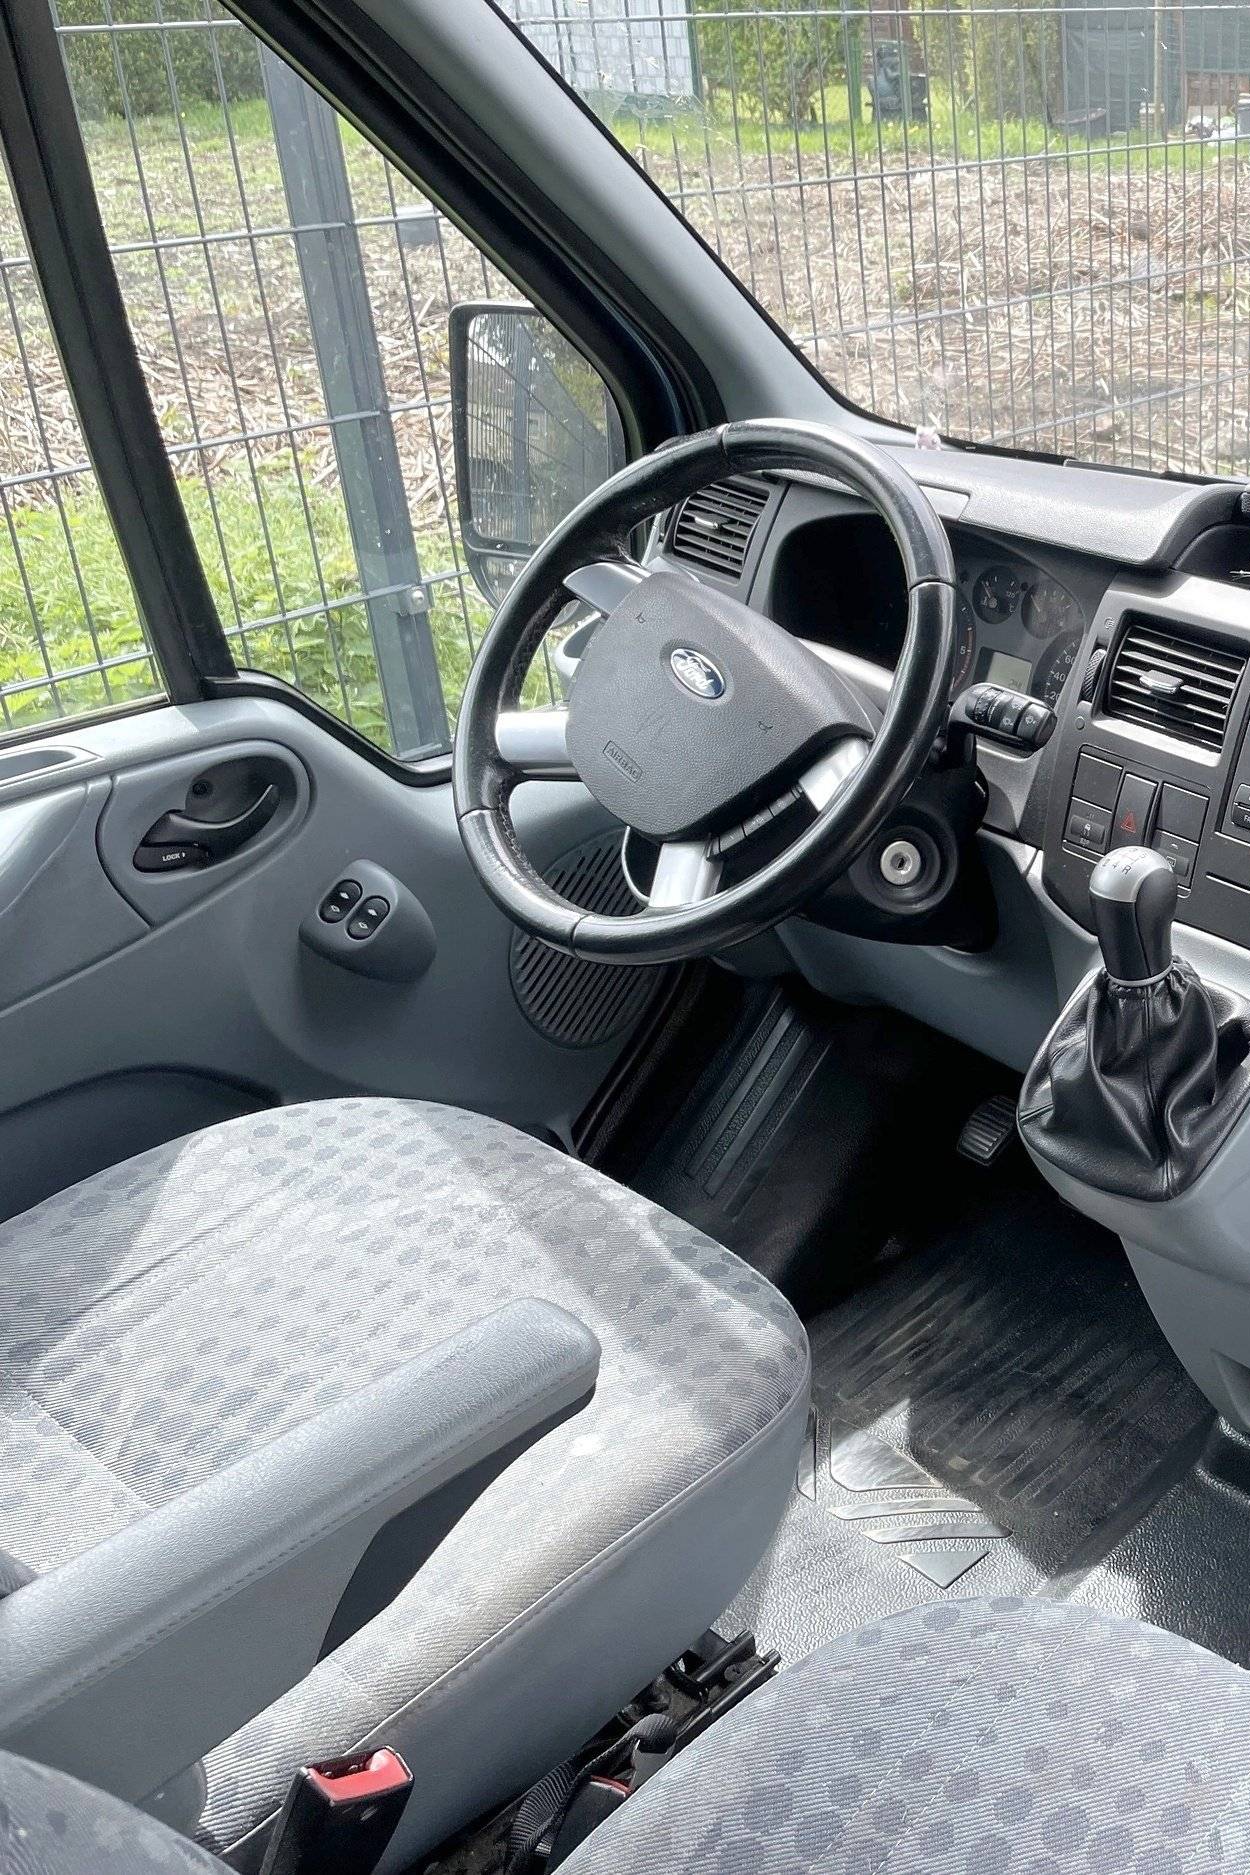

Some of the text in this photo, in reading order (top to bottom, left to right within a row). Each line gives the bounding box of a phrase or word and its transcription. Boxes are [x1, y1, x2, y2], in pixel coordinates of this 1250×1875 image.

[1053, 671, 1066, 682] 40
[606, 746, 641, 780] AIRBAG
[162, 852, 181, 862] LOCK
